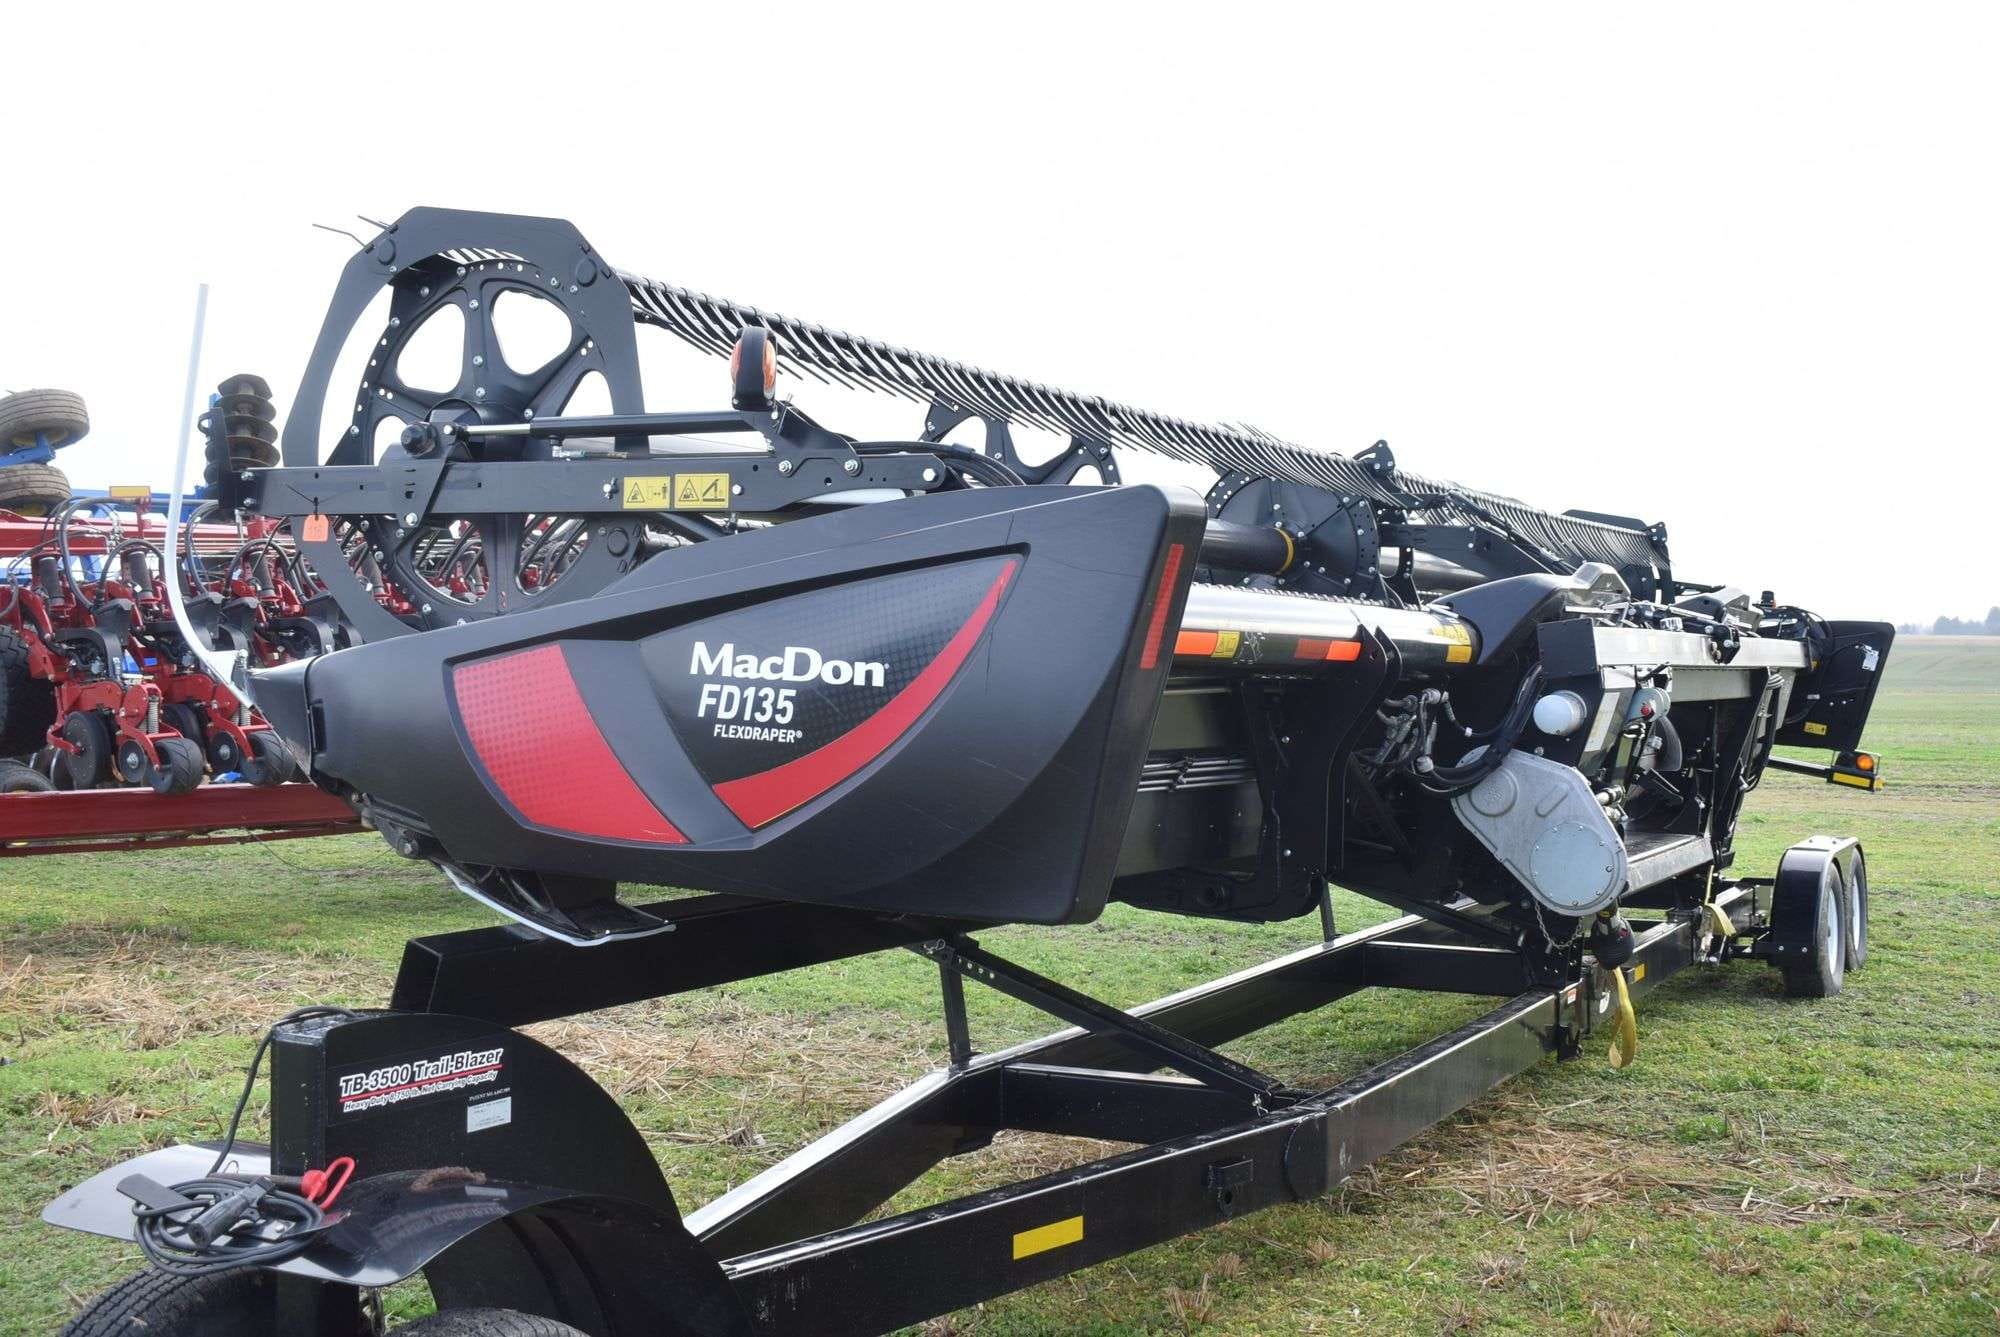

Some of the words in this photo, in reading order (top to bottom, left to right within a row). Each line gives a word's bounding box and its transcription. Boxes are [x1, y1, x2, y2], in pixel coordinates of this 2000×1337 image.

[697, 683, 797, 724] FD135
[339, 1064, 411, 1097] TB-3500
[413, 1048, 504, 1081] Trail-Blazer
[343, 1098, 369, 1113] Heavy
[369, 1094, 388, 1107] Duty
[467, 1070, 498, 1086] Capacity
